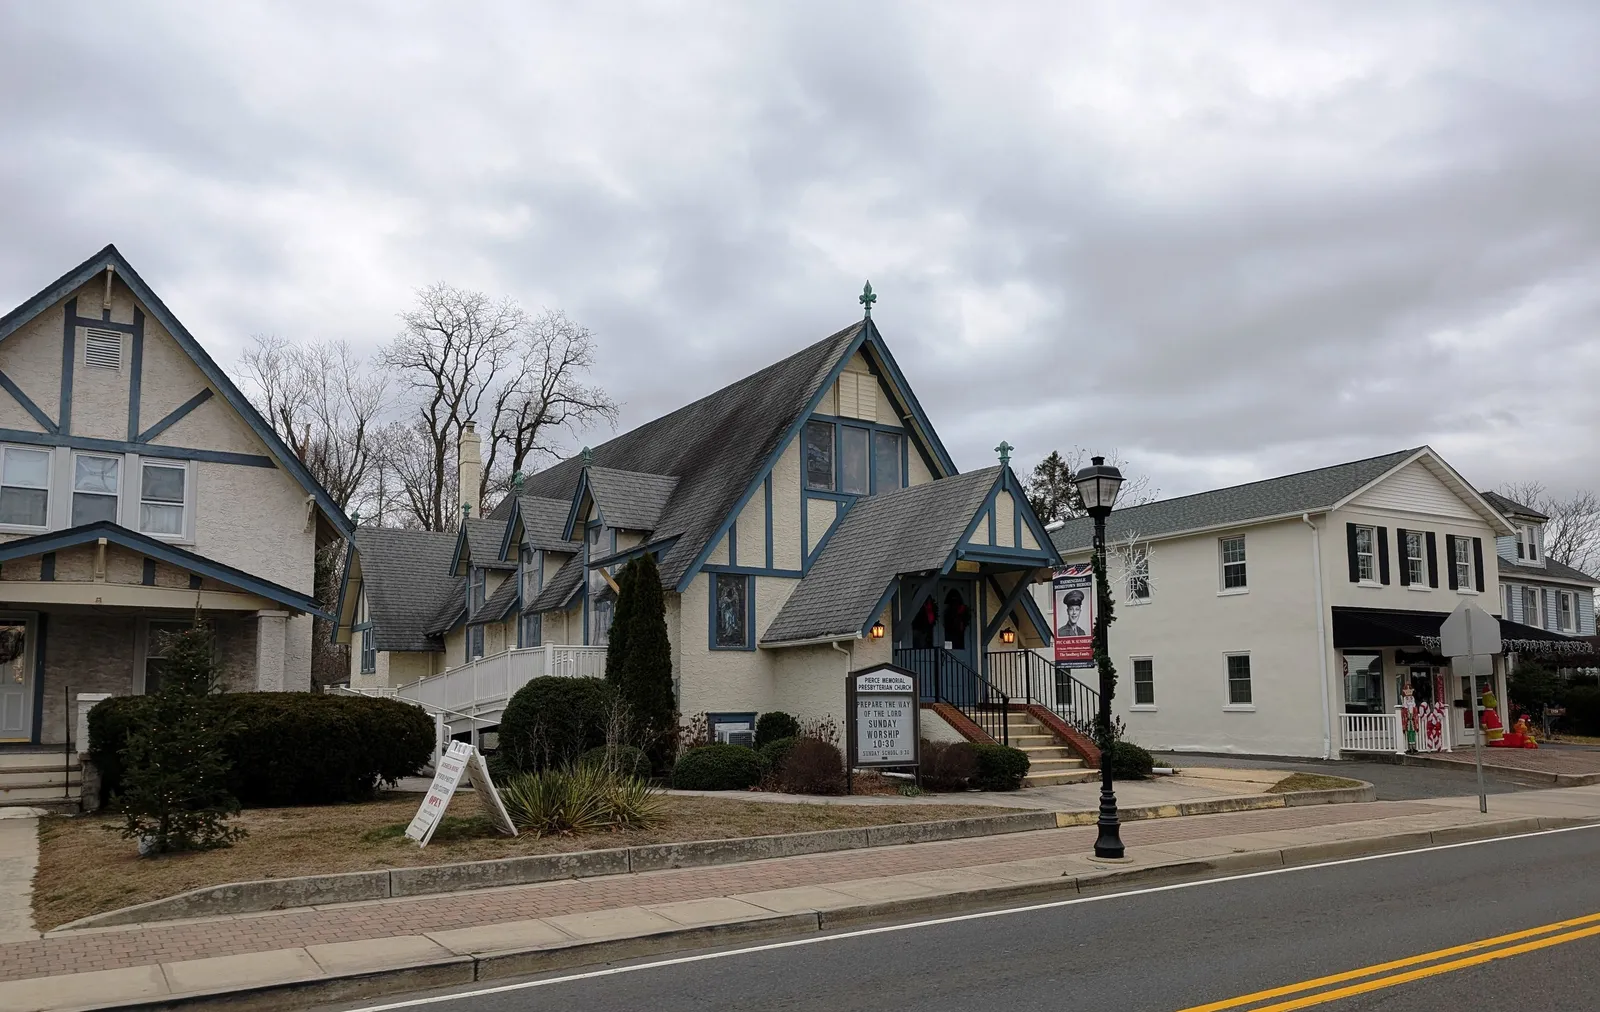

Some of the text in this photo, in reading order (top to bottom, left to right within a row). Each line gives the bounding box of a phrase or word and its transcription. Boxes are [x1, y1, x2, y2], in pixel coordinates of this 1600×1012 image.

[868, 720, 897, 728] SUNDAY
[866, 730, 900, 739] WORSHIP
[873, 740, 894, 748] 10:30
[428, 795, 442, 808] OPEN
